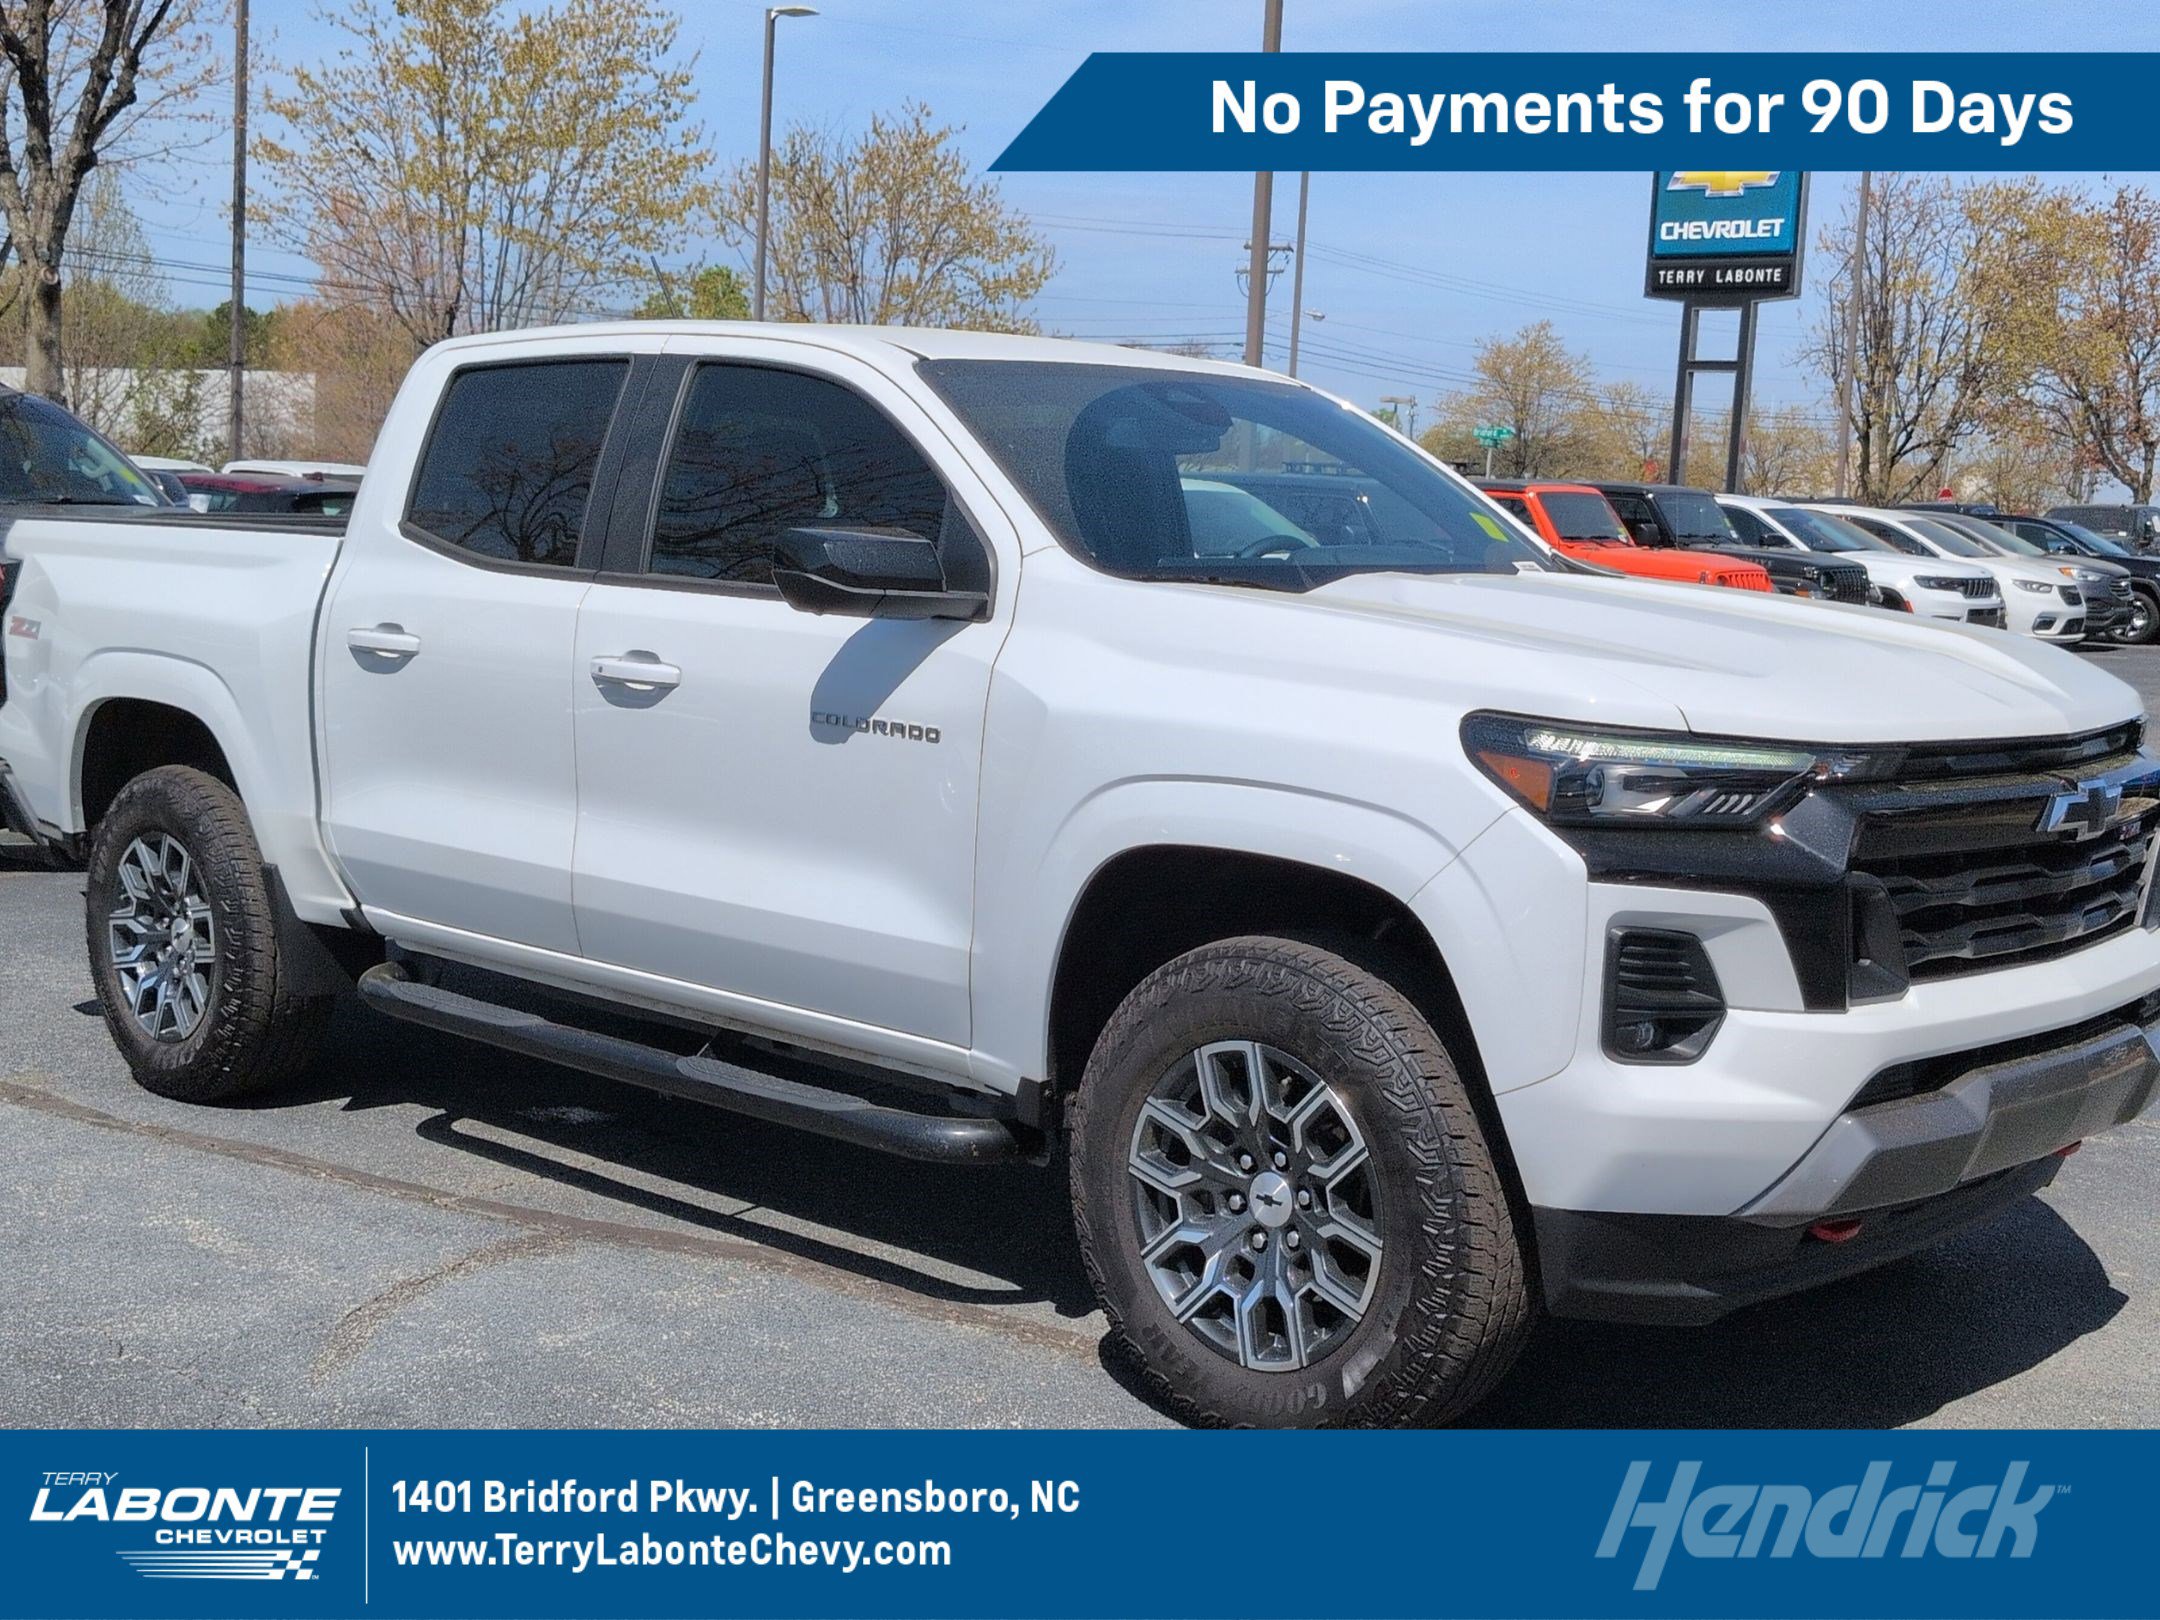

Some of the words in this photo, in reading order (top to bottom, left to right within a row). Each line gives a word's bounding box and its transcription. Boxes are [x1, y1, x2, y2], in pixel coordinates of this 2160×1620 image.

[1660, 218, 1785, 241] CHEVROLET
[1658, 270, 1705, 284] TERRY
[1715, 267, 1782, 284] LABONTE
[811, 711, 941, 744] COLORADO
